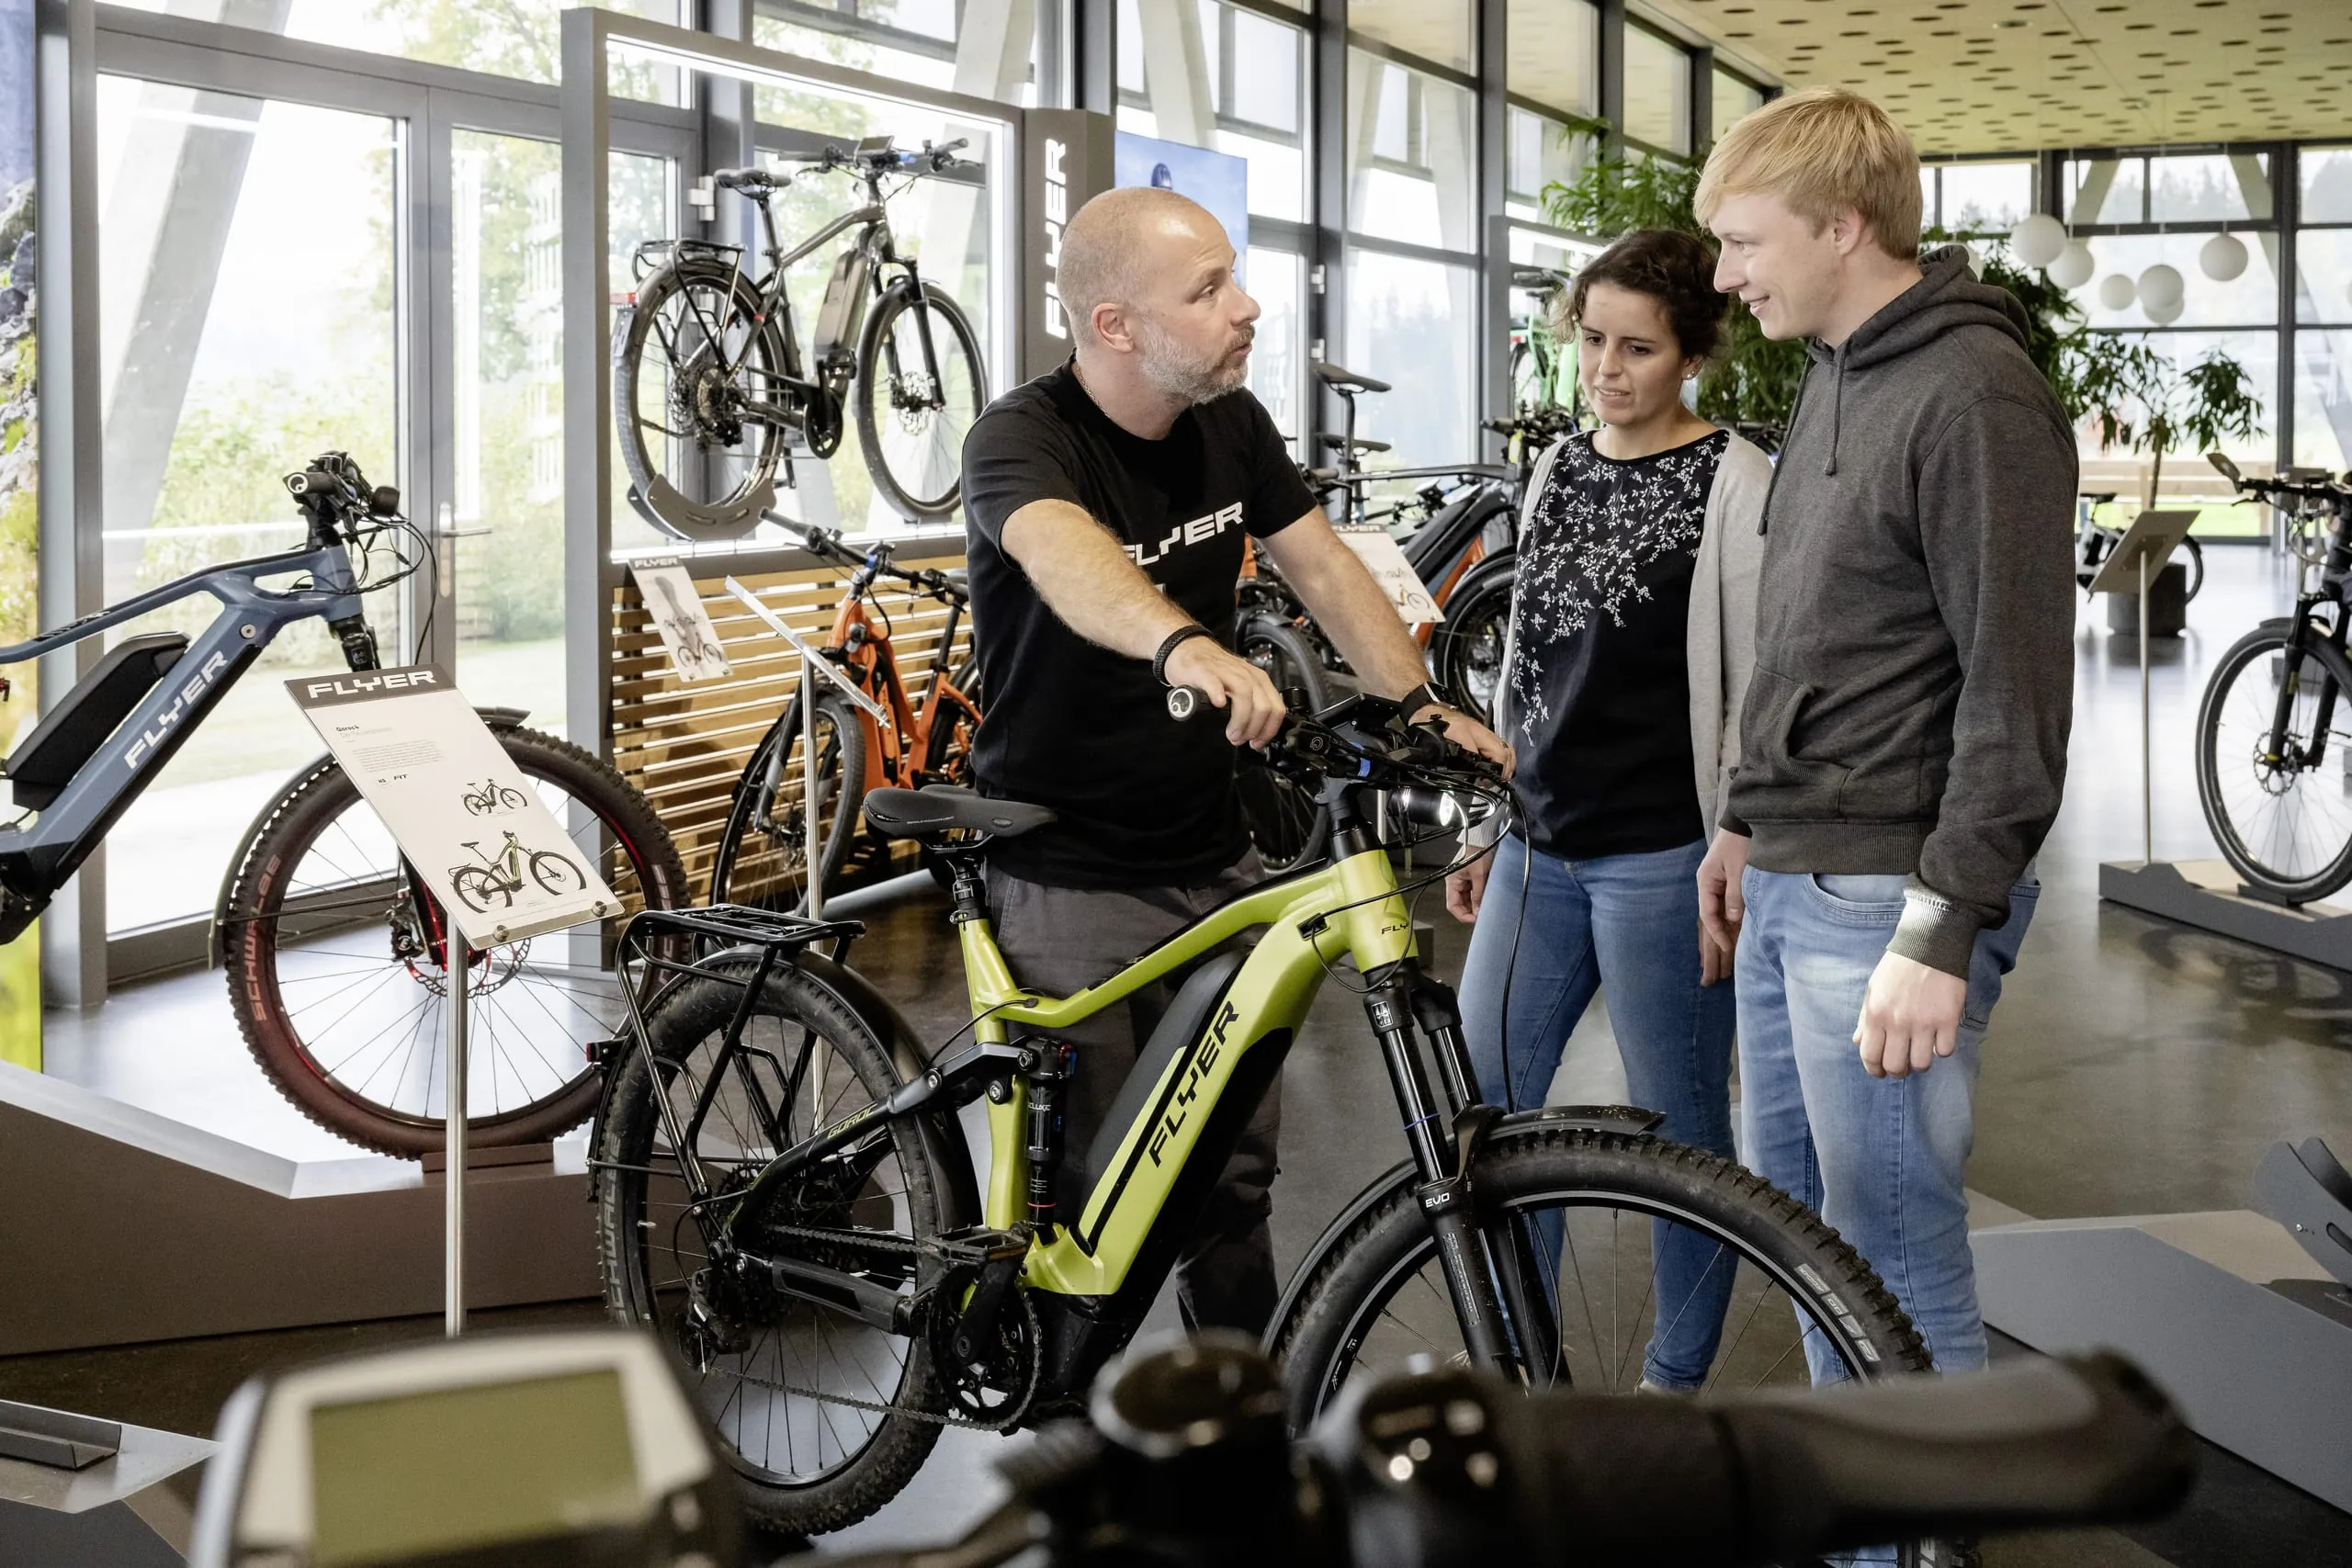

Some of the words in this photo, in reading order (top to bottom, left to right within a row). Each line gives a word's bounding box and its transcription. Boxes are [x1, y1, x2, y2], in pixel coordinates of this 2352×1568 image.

[634, 557, 678, 569] FLYER
[307, 670, 437, 699] FLYER
[124, 649, 229, 770] FLYER
[243, 854, 282, 1021] SCHWALBE
[1381, 922, 1410, 935] FLY
[1148, 1000, 1240, 1168] FLYER
[827, 1102, 879, 1140] GOROC
[1425, 1192, 1451, 1208] EVO
